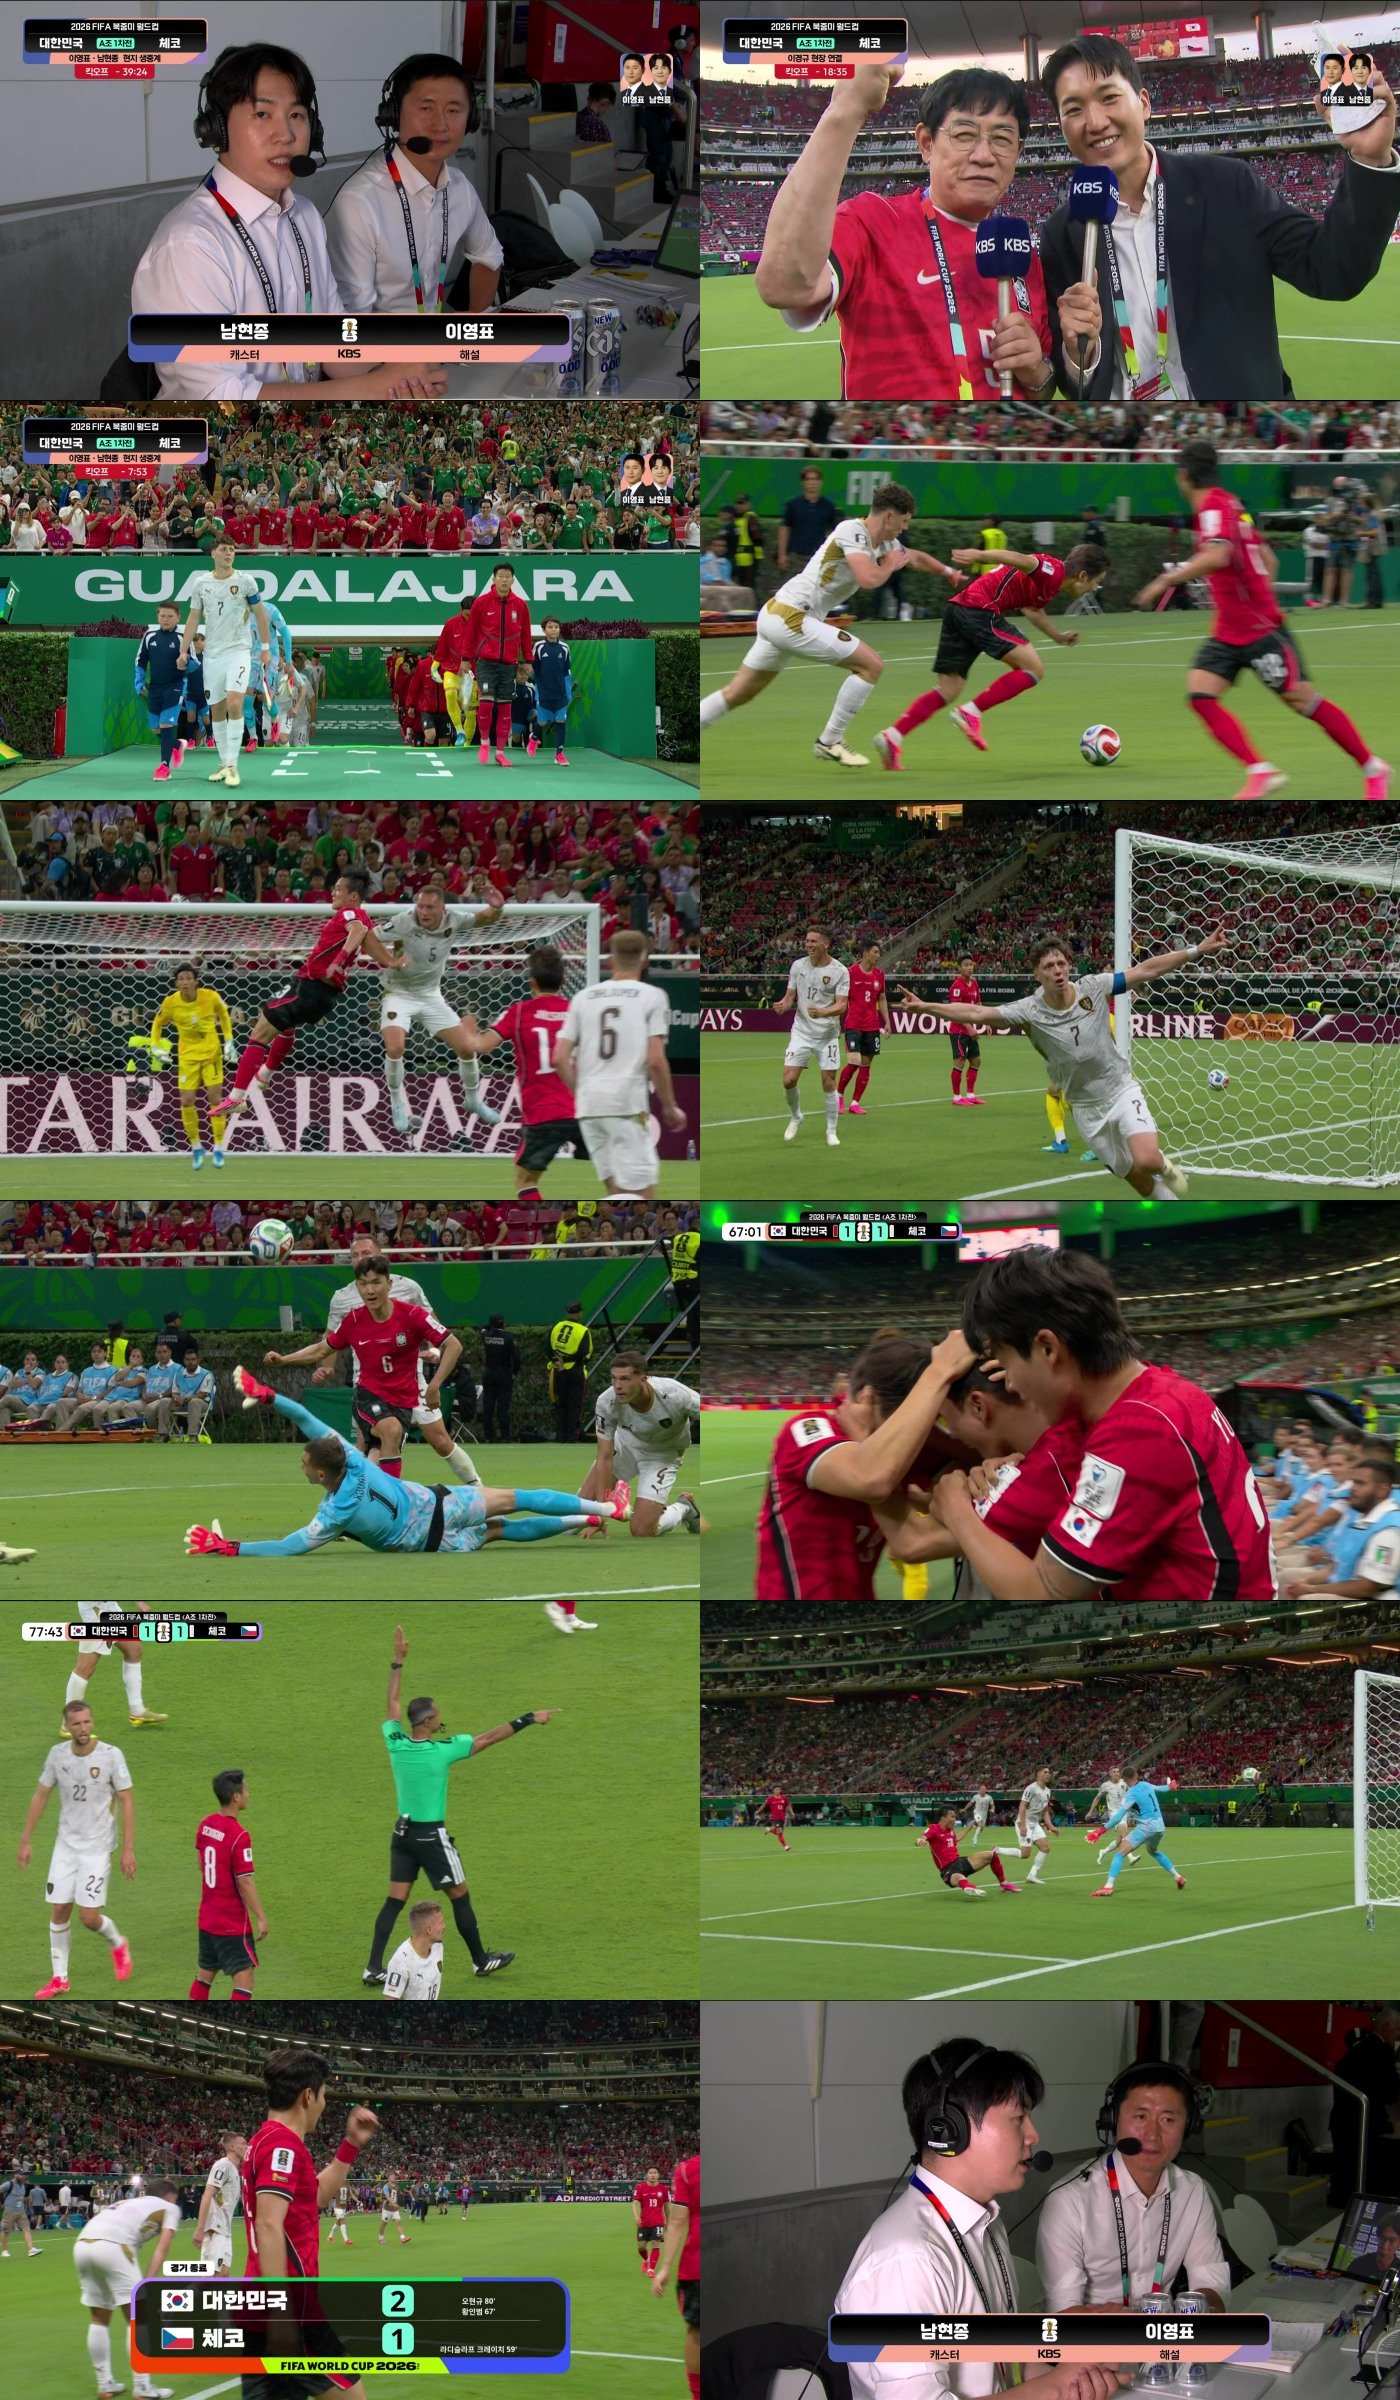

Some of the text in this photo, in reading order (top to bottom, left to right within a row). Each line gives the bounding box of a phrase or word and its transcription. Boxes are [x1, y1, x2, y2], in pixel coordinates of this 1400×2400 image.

[1073, 181, 1103, 194] KBS
[1157, 182, 1165, 210] 2026
[236, 223, 248, 240] FIFA
[245, 239, 261, 266] WORLD
[259, 266, 268, 283] CUP
[975, 237, 996, 254] KBS
[1004, 238, 1031, 253] KBS
[1107, 248, 1116, 265] CUP
[929, 225, 957, 315] FIFA WORLD CUP 2026
[1110, 265, 1121, 292] 2026
[593, 313, 613, 326] NEW
[217, 601, 224, 616] 7
[238, 666, 246, 679] 7
[428, 947, 437, 962] 5
[807, 986, 818, 999] 17
[864, 990, 871, 1002] 2
[700, 1008, 743, 1031] AYS
[1131, 1013, 1215, 1039] RLINE
[599, 1006, 619, 1060] 6
[1070, 1025, 1079, 1047] 7
[827, 1045, 838, 1058] 17
[1131, 1099, 1142, 1115] 7
[382, 1355, 394, 1374] 6
[82, 1377, 106, 1386] FIFA
[655, 1467, 669, 1484] 4
[368, 1487, 398, 1521] 1
[73, 1784, 87, 1801] 22
[1148, 1793, 1157, 1813] 1
[204, 1846, 216, 1889] 8
[85, 1875, 105, 1894] 22
[427, 1983, 438, 2000] 18
[555, 2194, 574, 2202] ADI
[649, 2199, 658, 2207] 19
